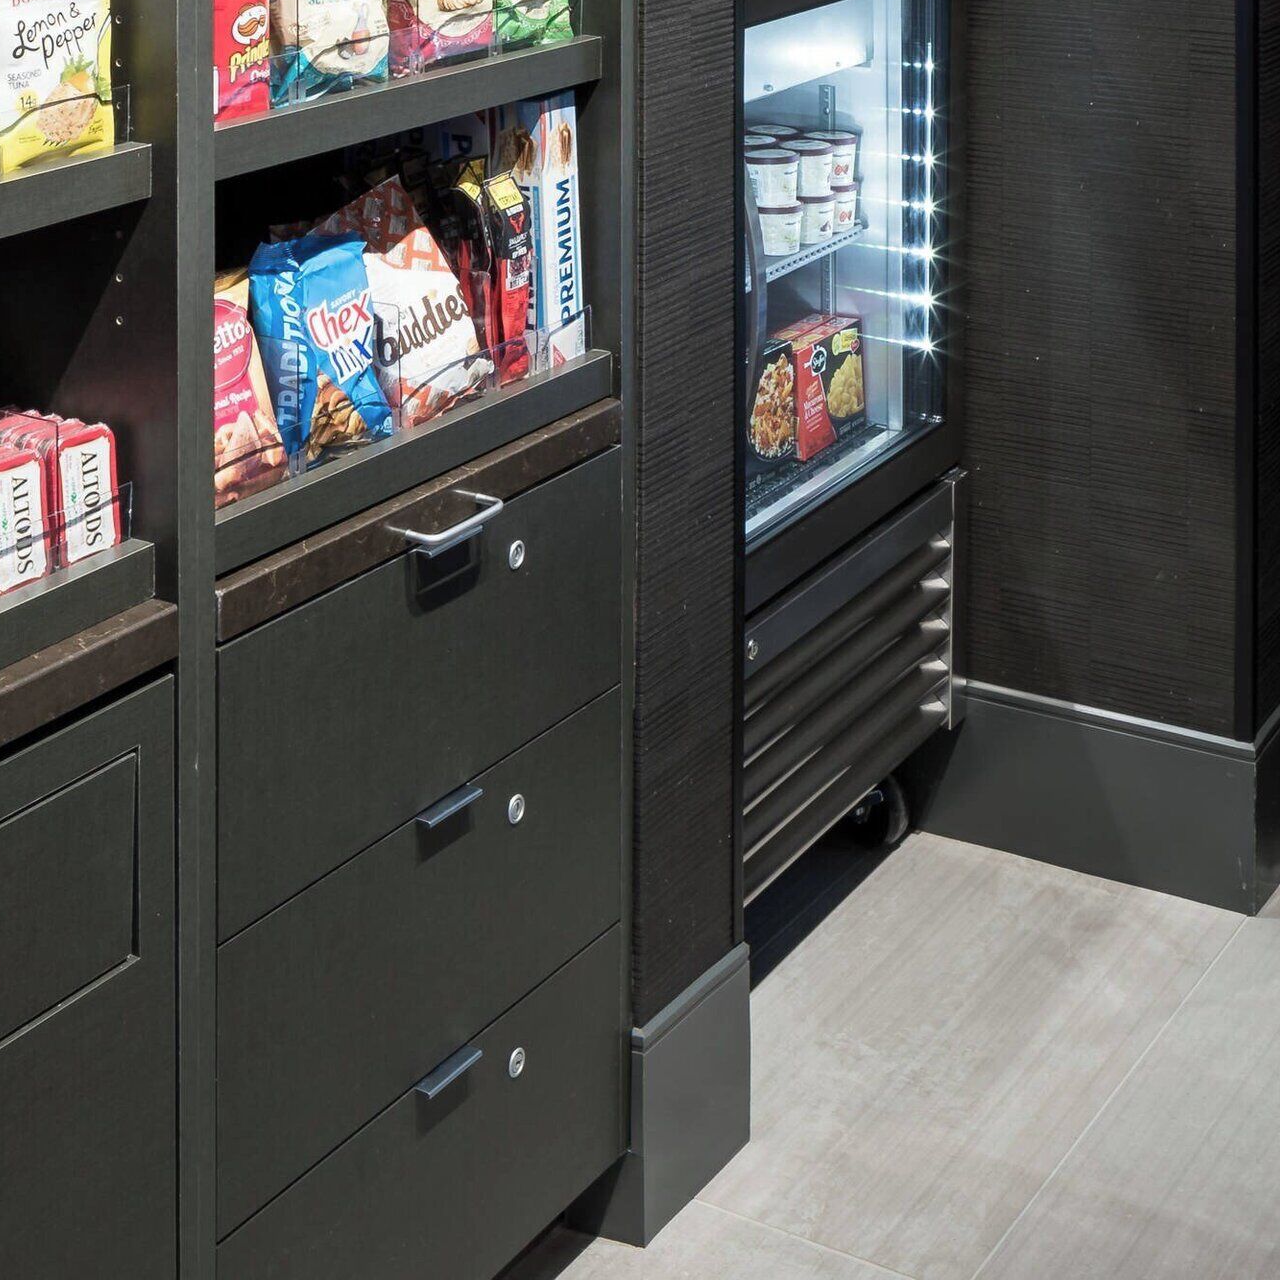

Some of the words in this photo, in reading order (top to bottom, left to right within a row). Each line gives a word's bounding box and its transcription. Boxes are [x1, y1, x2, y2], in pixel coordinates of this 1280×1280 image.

[12, 10, 64, 60] Lemon
[69, 1, 81, 19] &
[41, 12, 98, 70] Pepper
[229, 37, 271, 84] Pringle
[557, 177, 574, 328] PREMIUM
[308, 293, 371, 349] Chex
[11, 476, 35, 575] ALTOIDS
[80, 451, 104, 547] ALTOIDS
